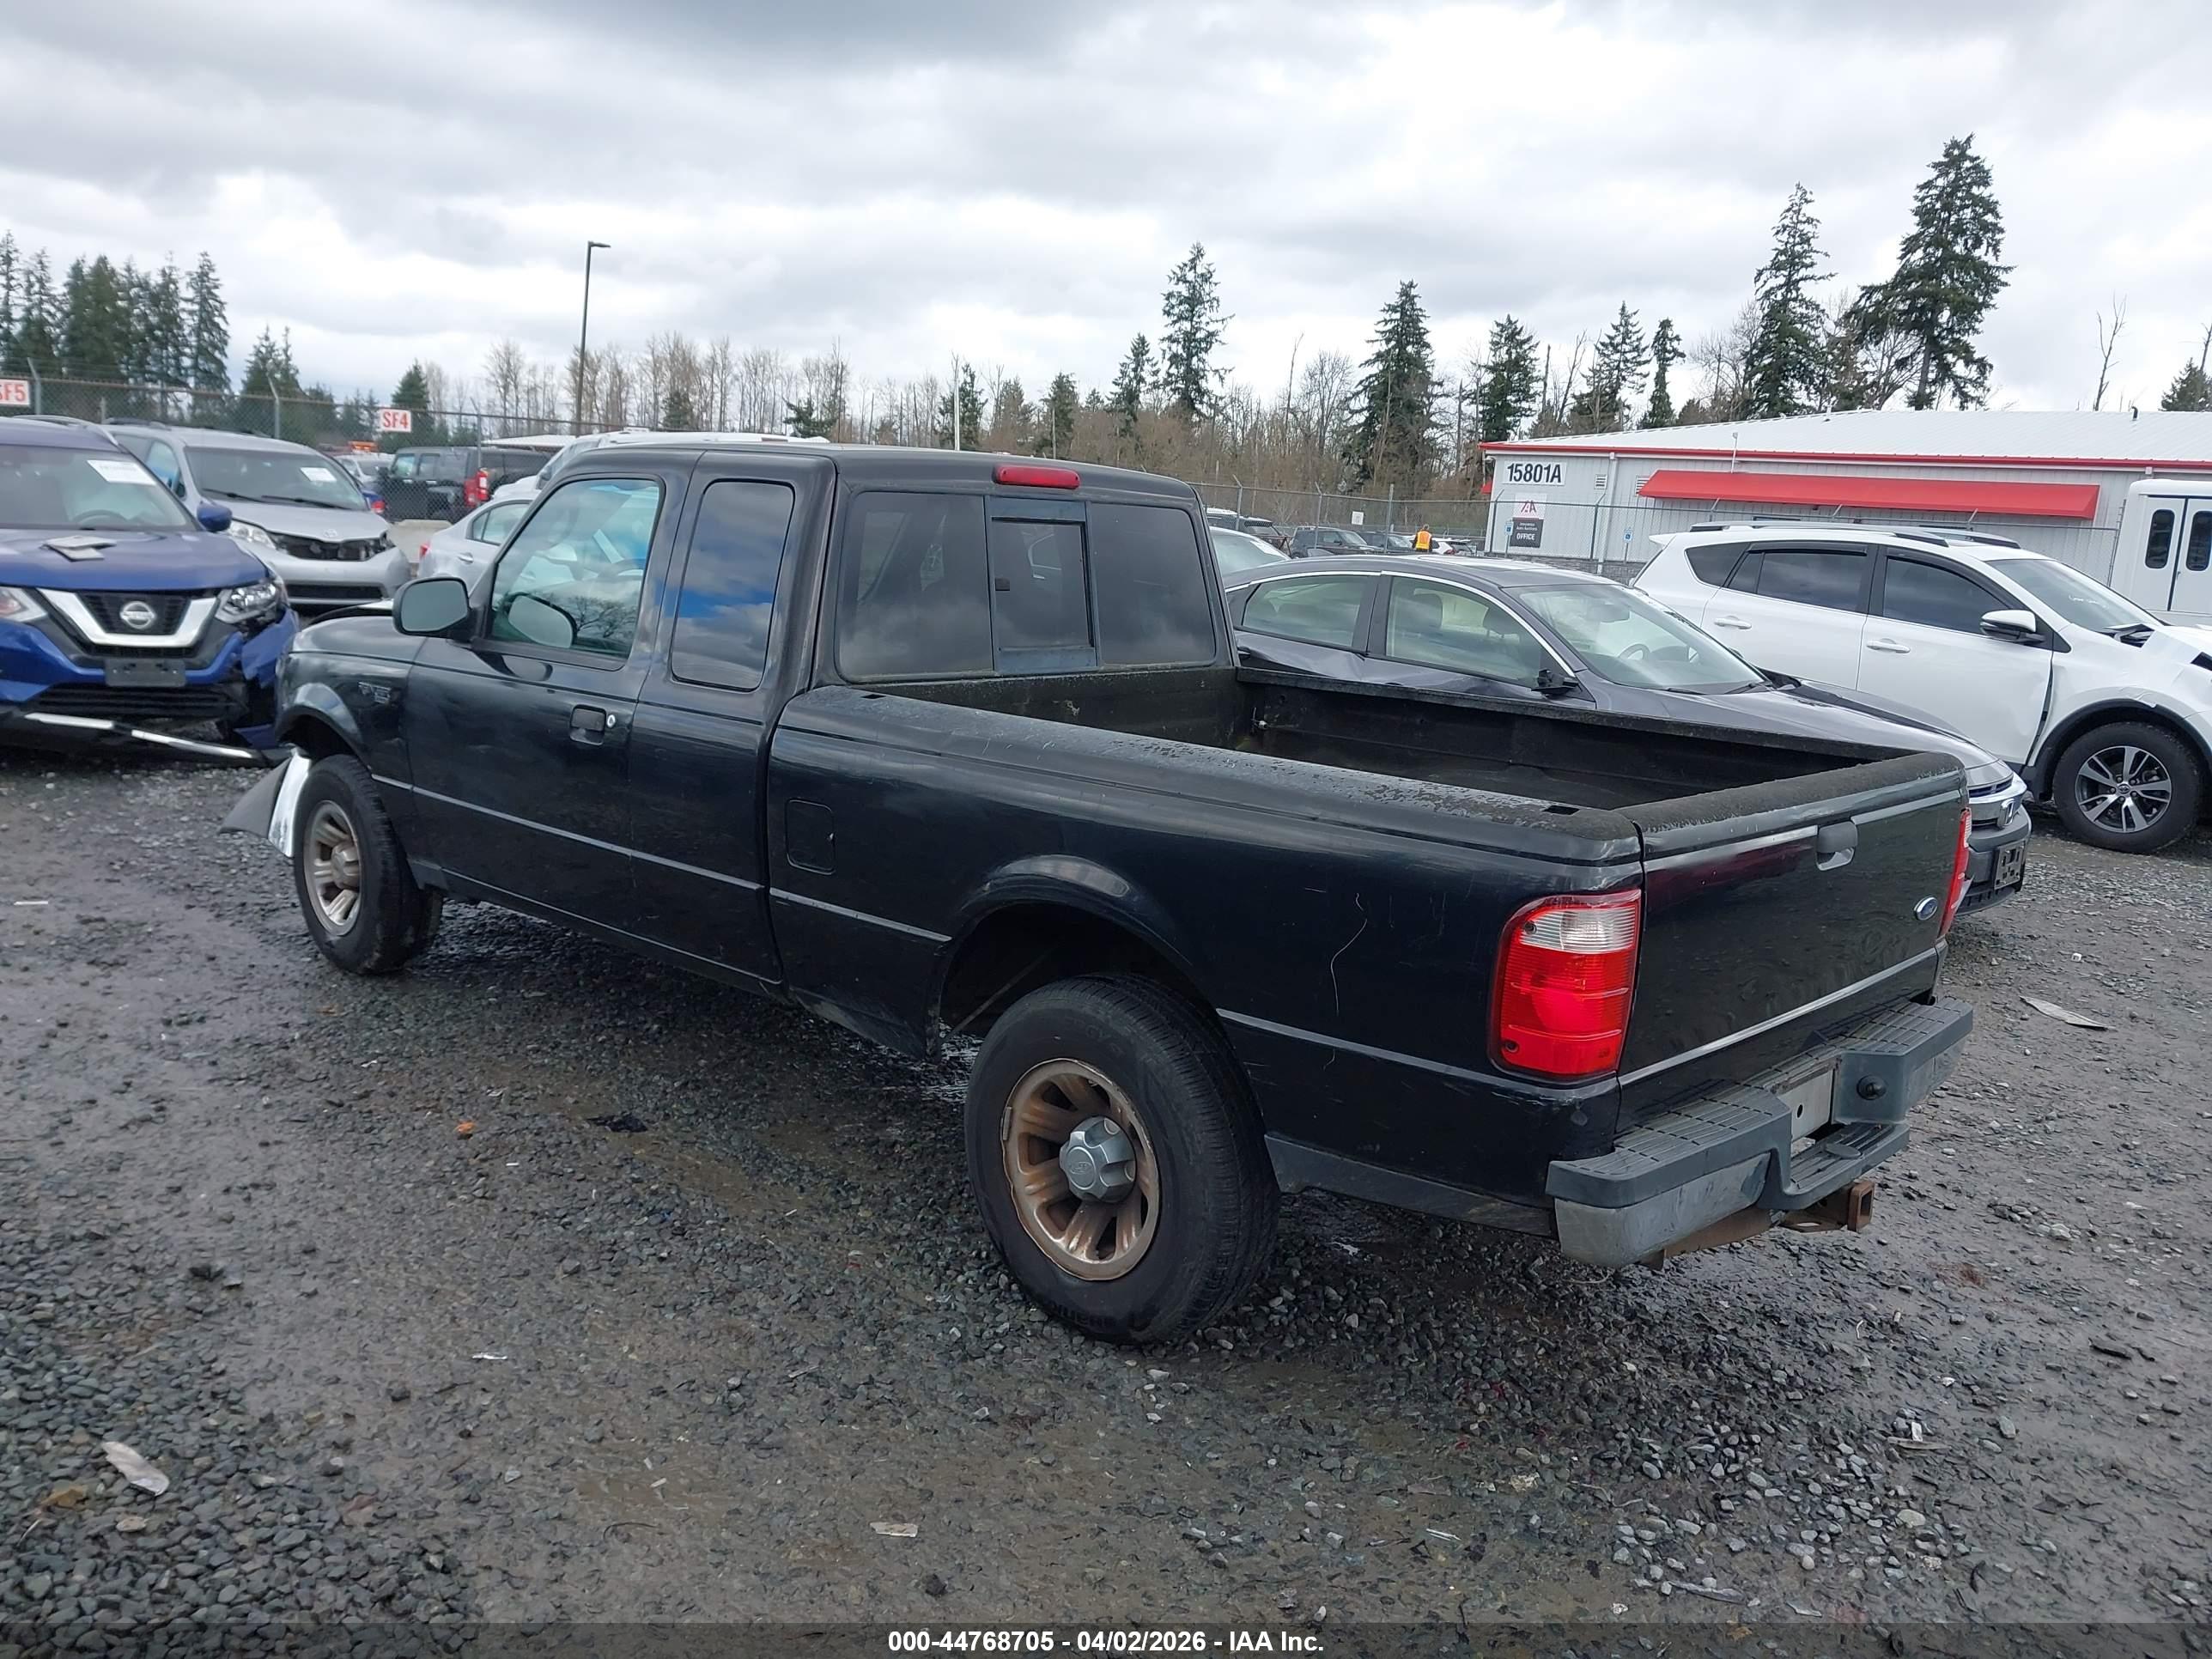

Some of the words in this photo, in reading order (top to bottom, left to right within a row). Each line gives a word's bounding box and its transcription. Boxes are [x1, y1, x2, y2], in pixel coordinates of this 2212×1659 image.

[383, 411, 409, 428] SF4
[1507, 463, 1561, 483] 15801A
[1516, 532, 1535, 541] OFFICE
